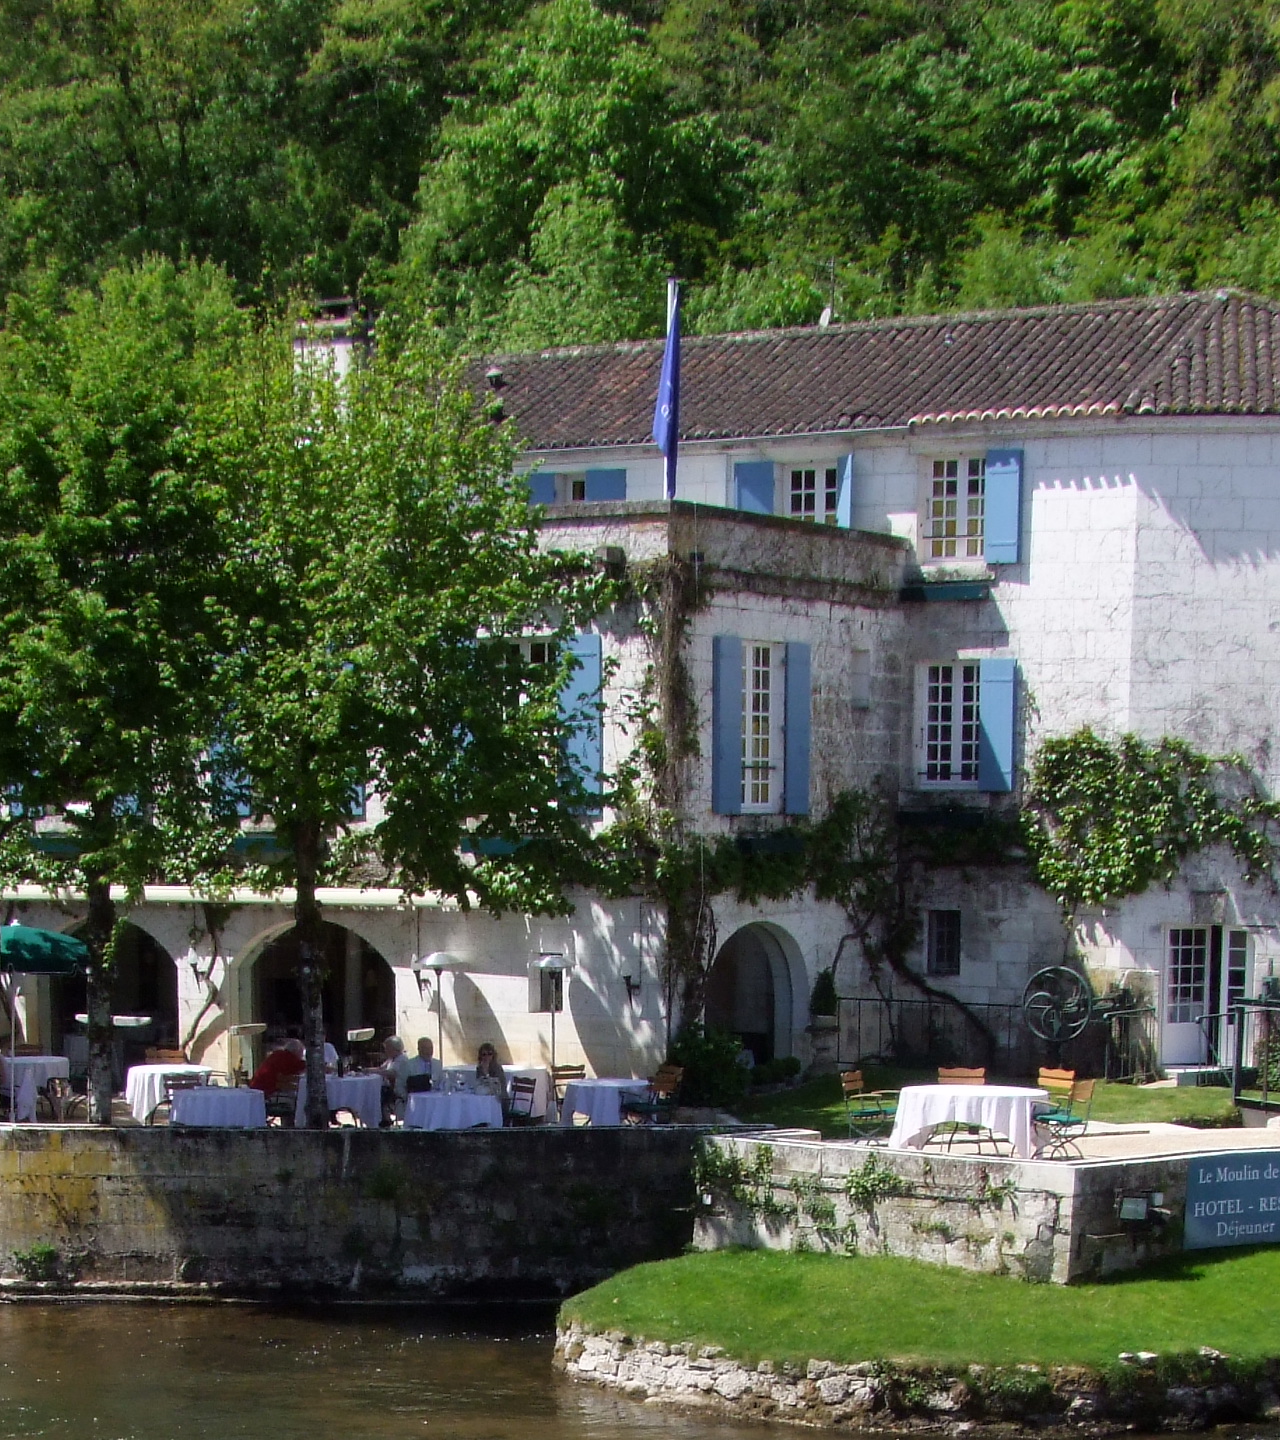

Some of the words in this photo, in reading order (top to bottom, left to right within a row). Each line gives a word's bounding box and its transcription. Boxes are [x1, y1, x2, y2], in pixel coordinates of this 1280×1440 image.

[1199, 1168, 1212, 1184] Le
[1215, 1163, 1260, 1183] Moulin
[1264, 1162, 1279, 1180] de
[1193, 1199, 1244, 1217] HOTEL
[1216, 1219, 1275, 1239] Déjeuner
